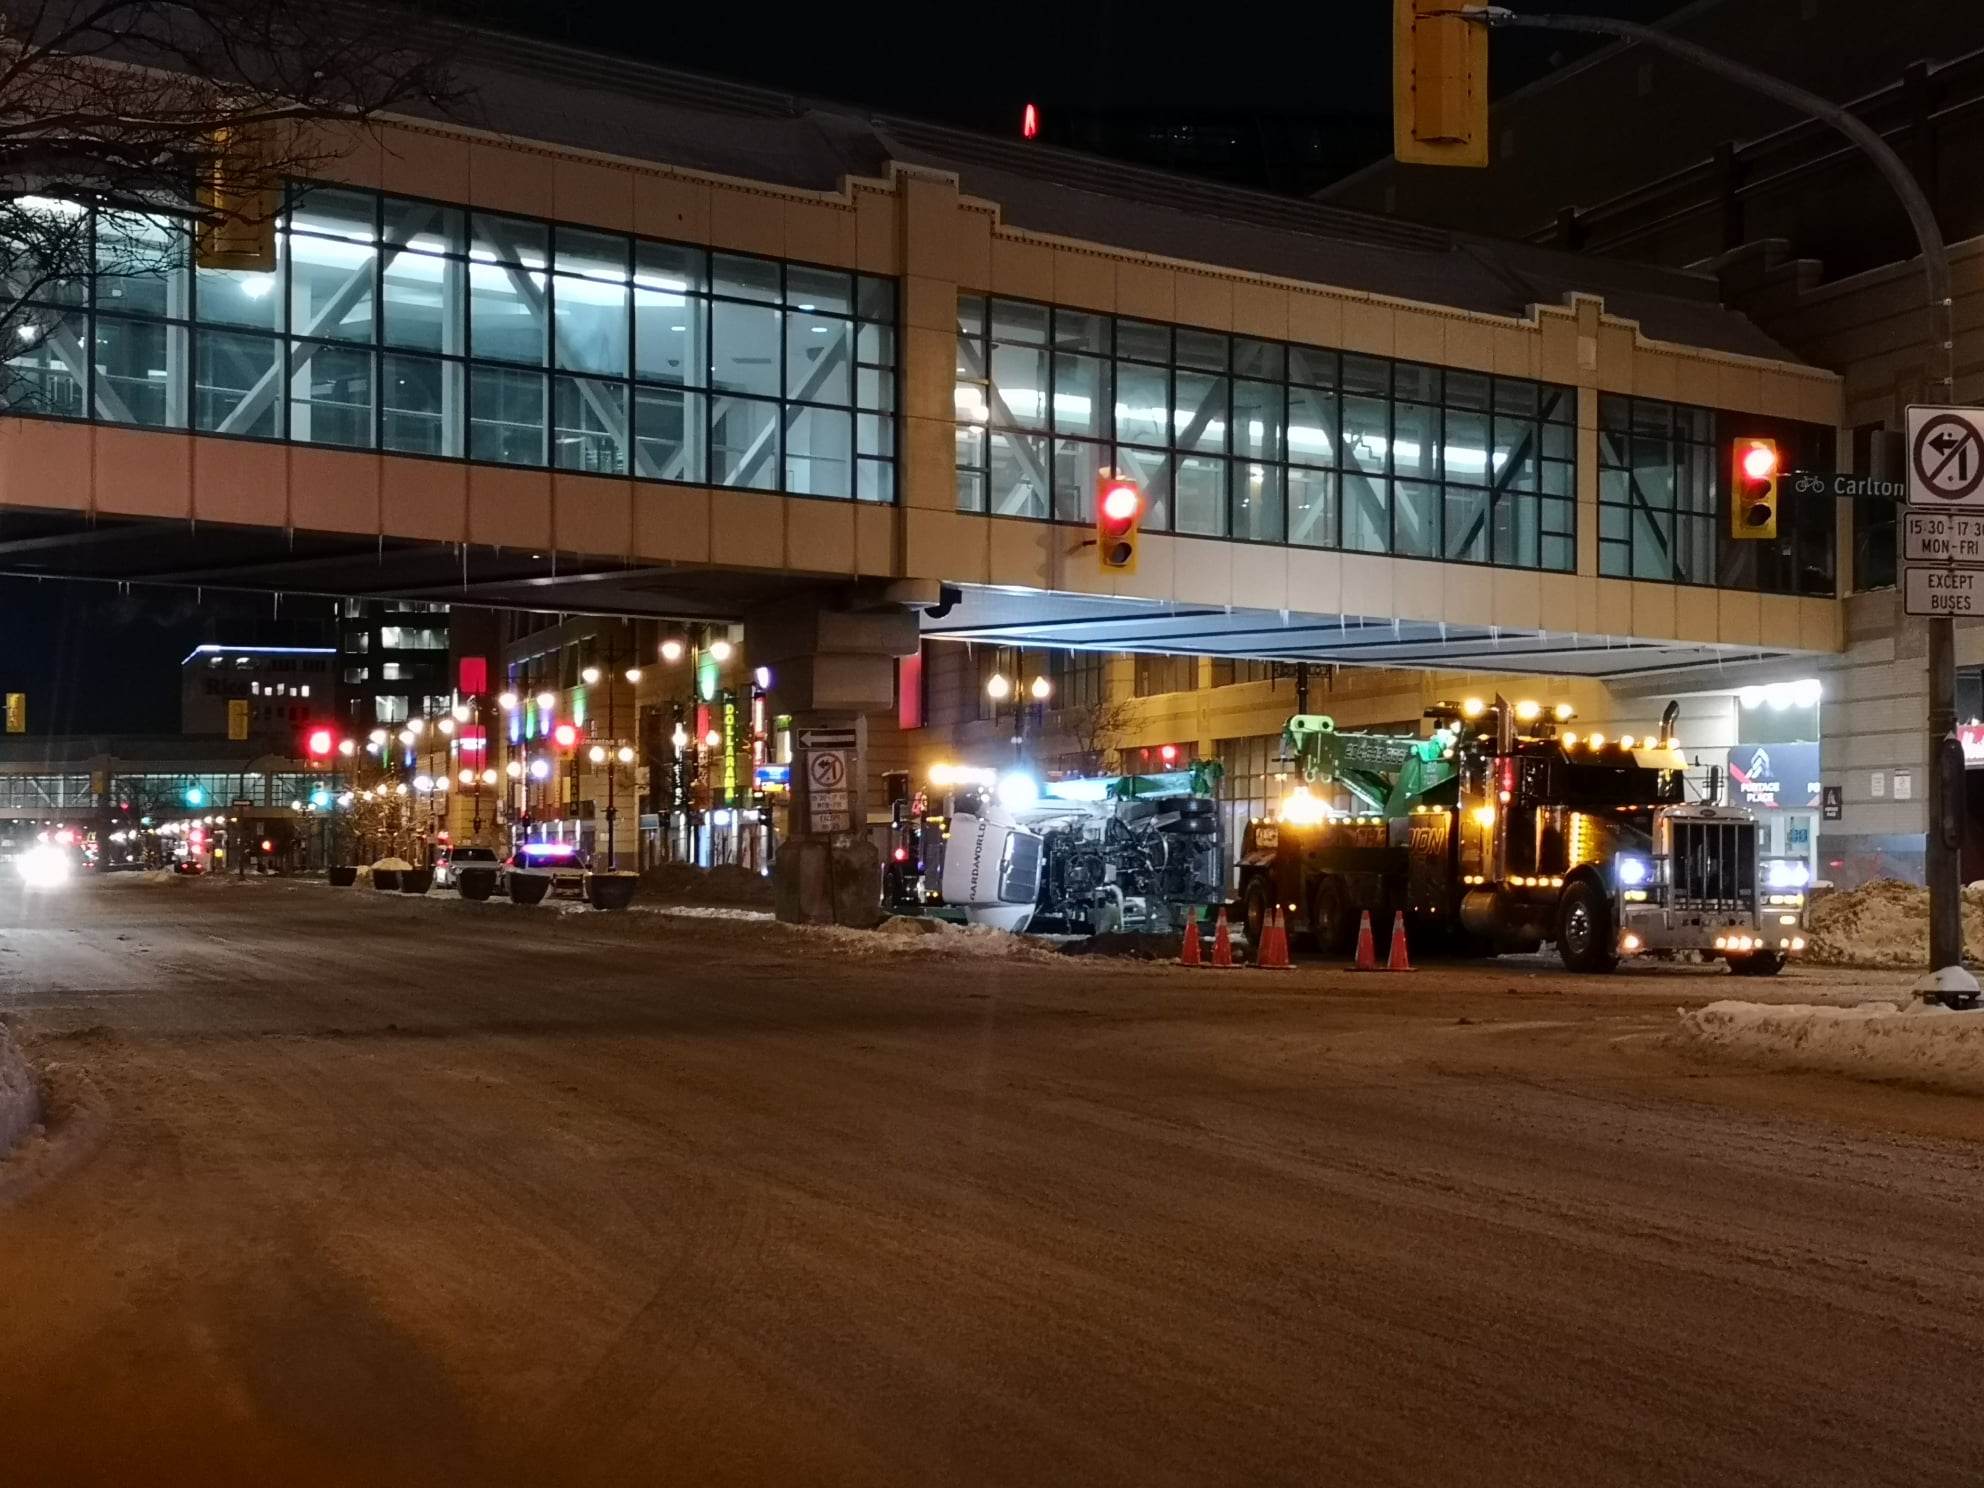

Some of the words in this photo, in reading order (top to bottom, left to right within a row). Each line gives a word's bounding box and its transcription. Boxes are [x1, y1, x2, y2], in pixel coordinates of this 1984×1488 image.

[1834, 476, 1905, 497] Carlton
[1921, 538, 1979, 555] MON-FRI
[1928, 573, 1974, 590] EXCEPT
[1931, 594, 1971, 610] BUSES
[725, 703, 737, 800] DOLLARAMA
